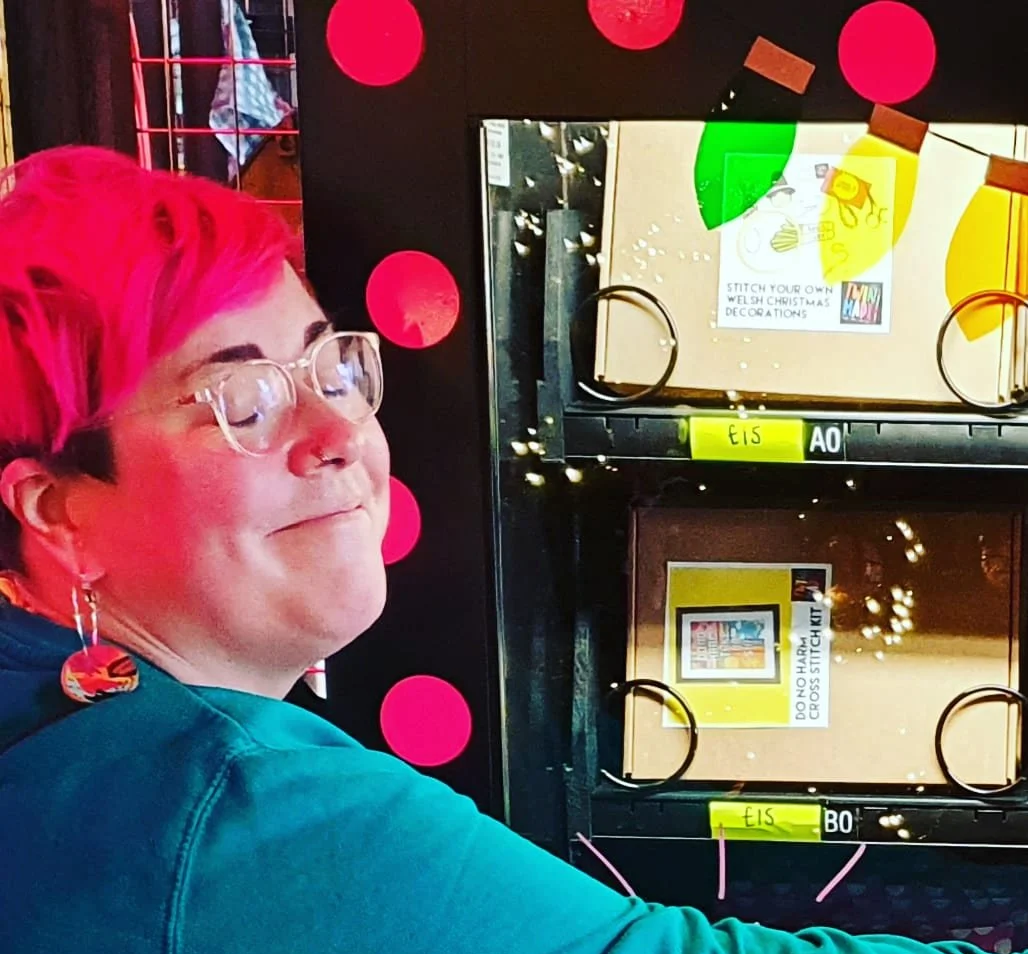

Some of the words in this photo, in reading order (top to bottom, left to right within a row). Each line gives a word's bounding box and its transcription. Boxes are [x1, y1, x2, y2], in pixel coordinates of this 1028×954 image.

[726, 282, 767, 294] STITCH
[770, 283, 801, 295] YOUR
[804, 284, 834, 295] OWN
[727, 294, 764, 306] WELSH
[766, 296, 831, 308] CHRISTMAS
[725, 307, 808, 320] DECORATIONS
[809, 425, 841, 454] A0
[810, 606, 823, 628] KIT
[796, 636, 808, 674] HARM
[809, 631, 822, 674] STITCH
[796, 678, 808, 699] NO
[809, 677, 821, 721] CROSS
[795, 701, 807, 721] DO
[824, 809, 854, 834] B0
